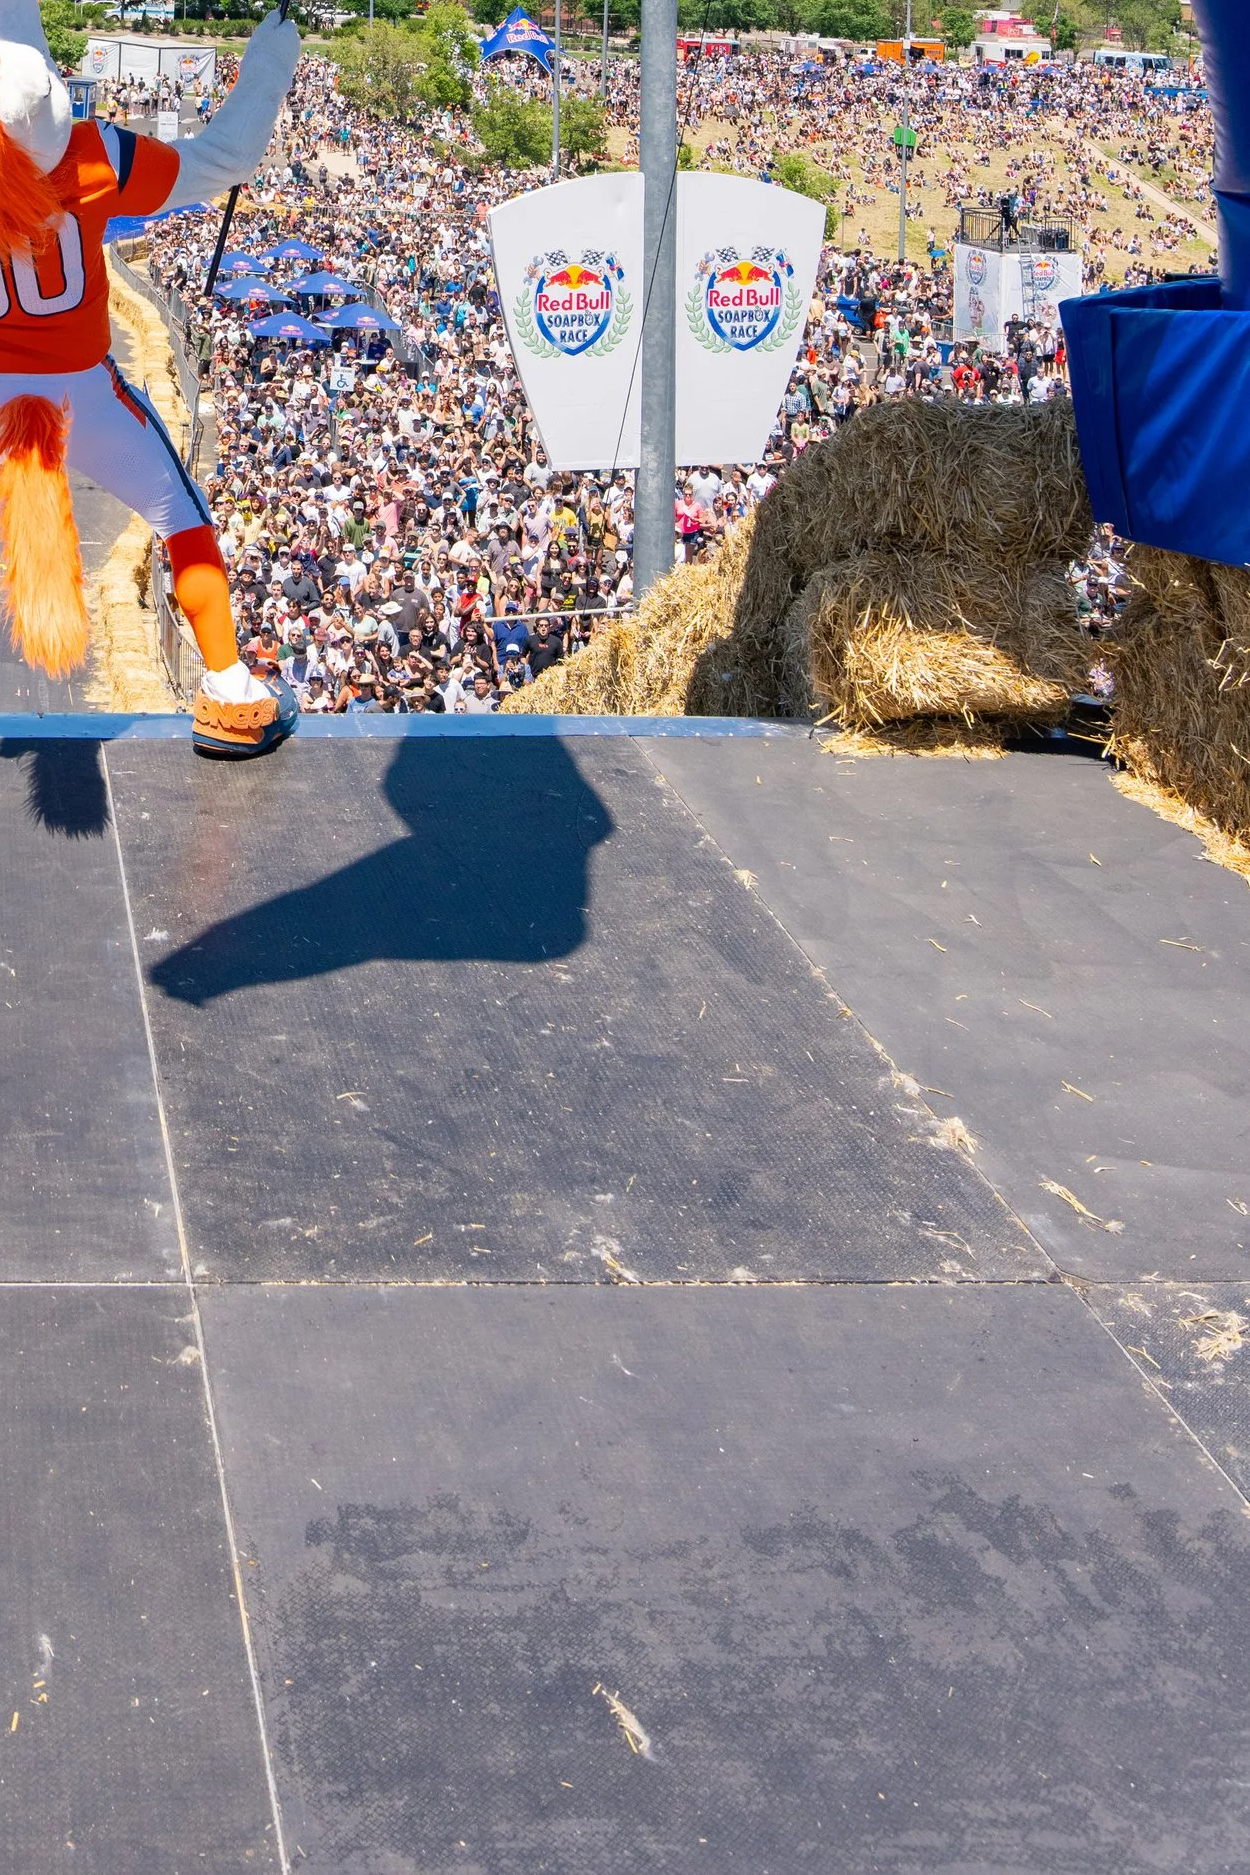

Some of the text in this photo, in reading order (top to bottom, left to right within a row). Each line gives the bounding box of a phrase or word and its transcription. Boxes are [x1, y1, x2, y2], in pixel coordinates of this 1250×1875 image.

[538, 291, 610, 312] Red Bull
[709, 287, 779, 307] Red Bull
[547, 312, 601, 328] SOAPBOX
[717, 308, 771, 323] SOAPBOX
[559, 329, 588, 343] RACE
[730, 325, 758, 339] RACE
